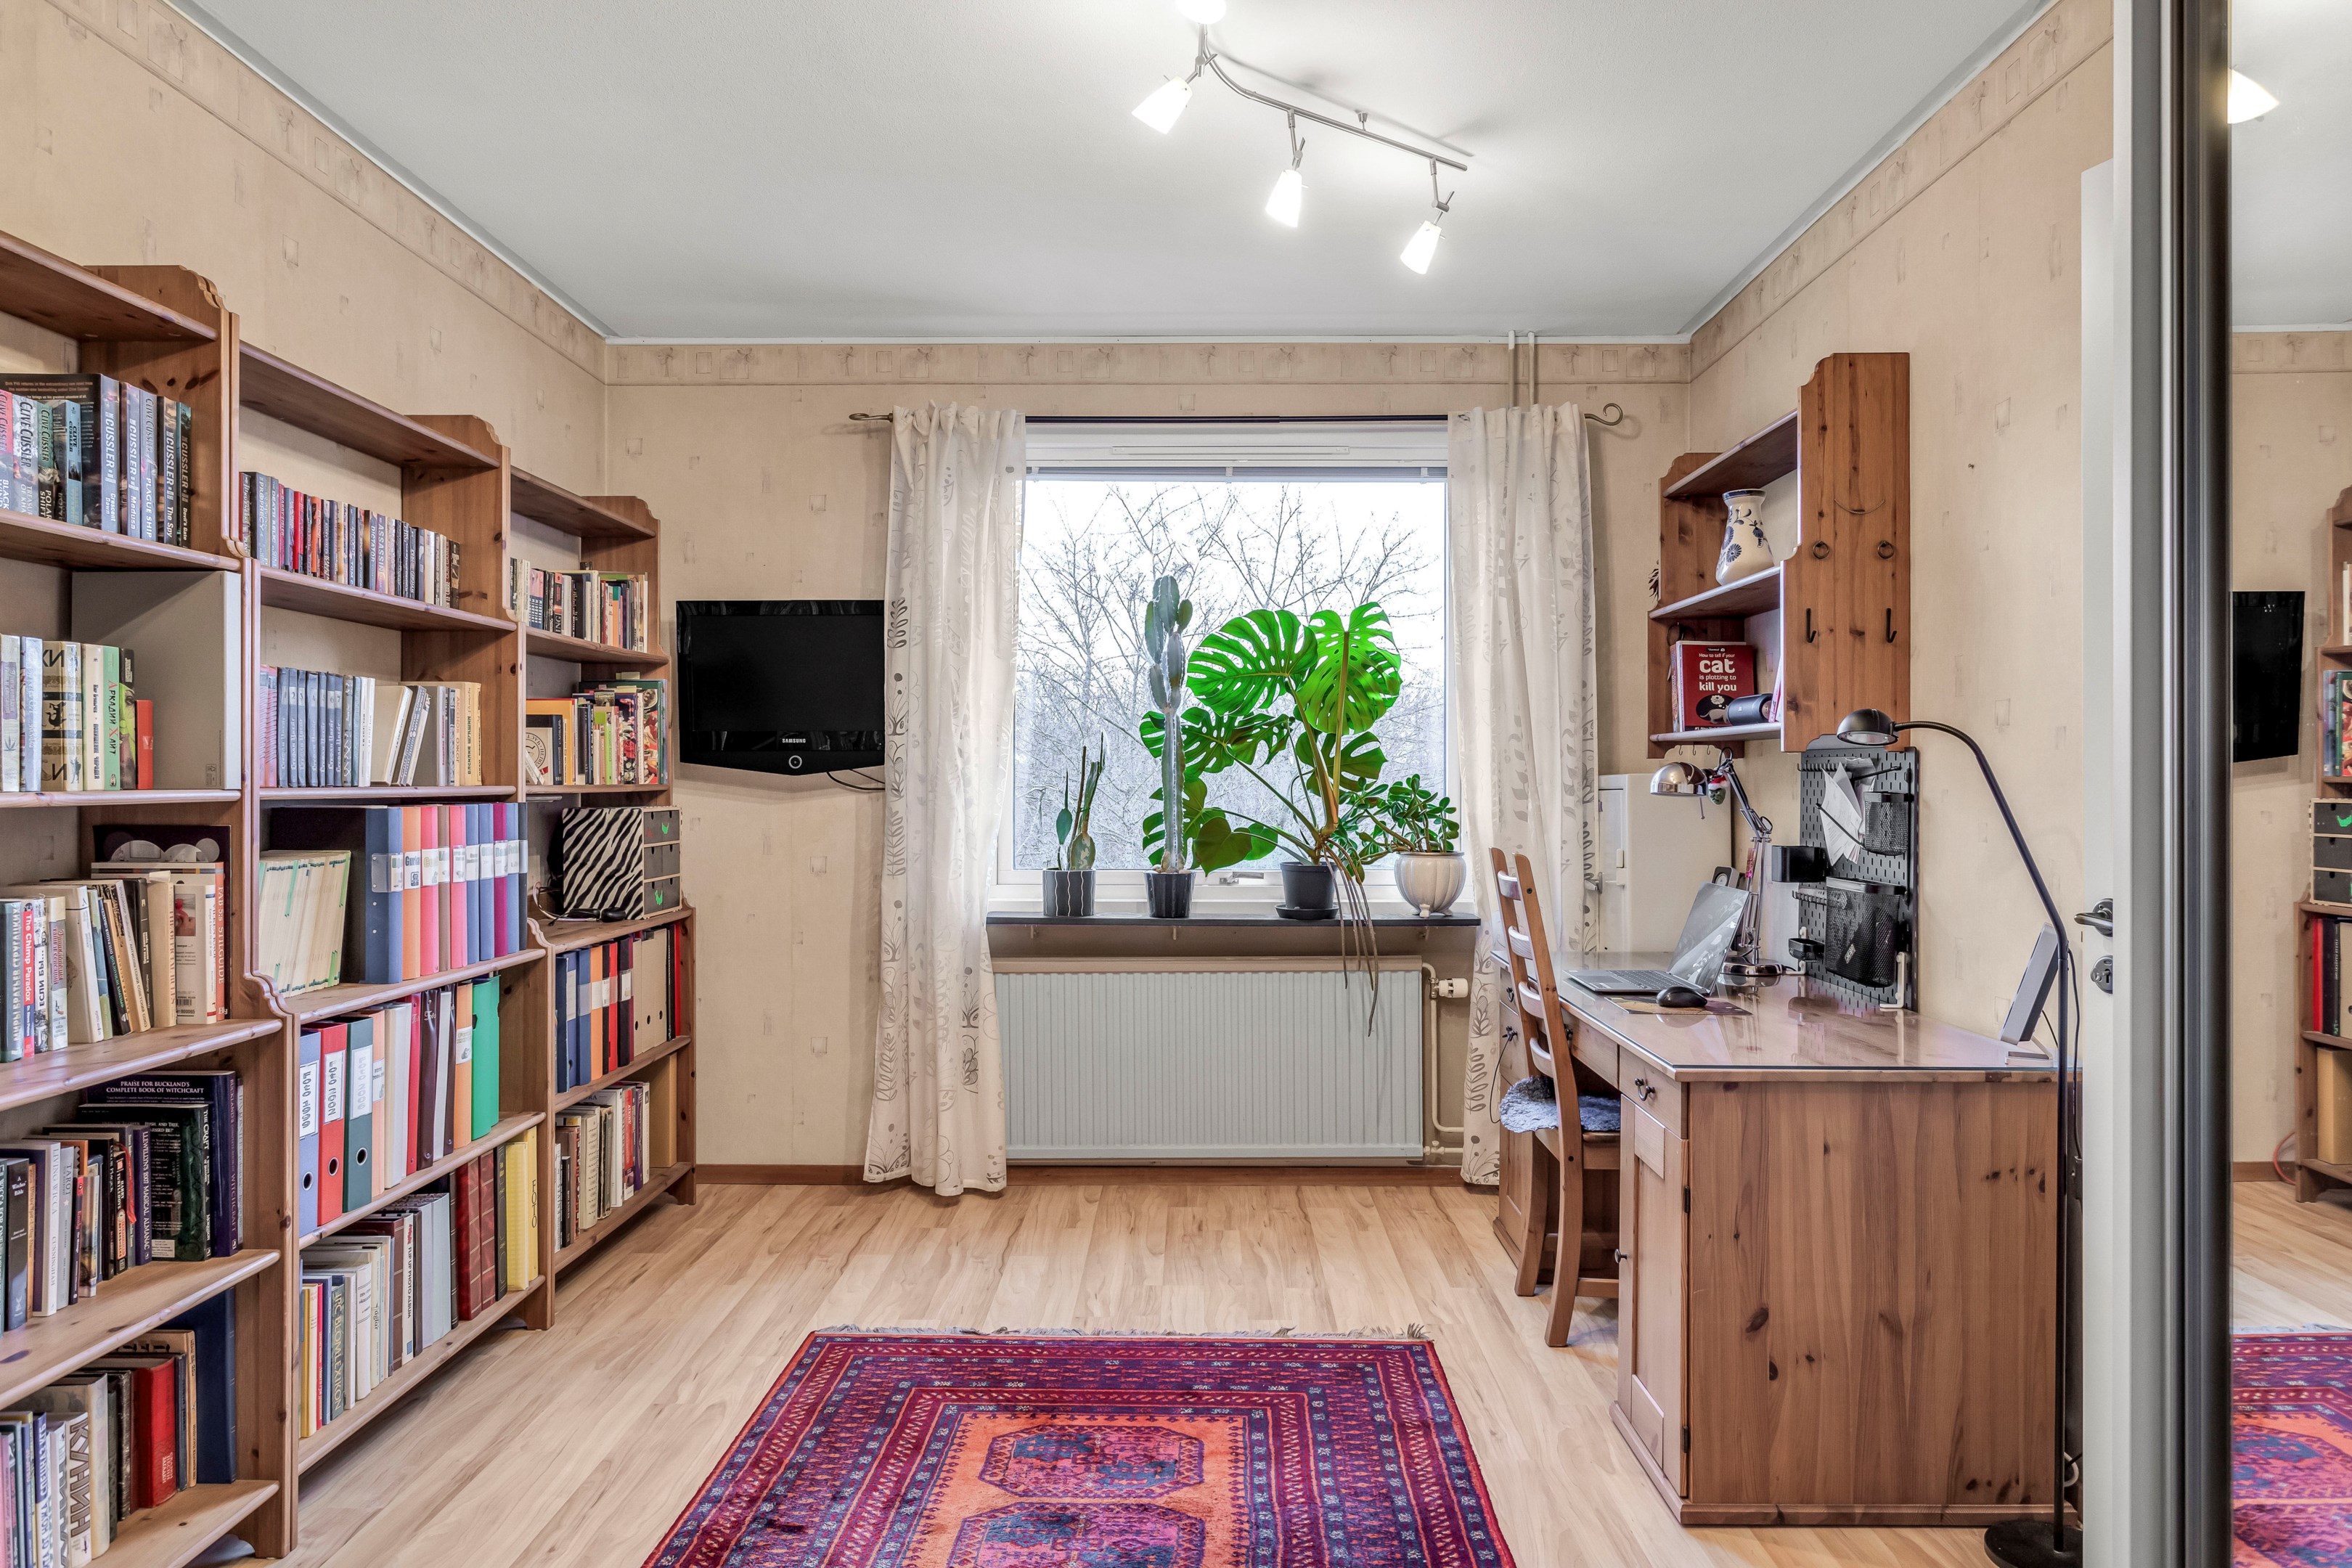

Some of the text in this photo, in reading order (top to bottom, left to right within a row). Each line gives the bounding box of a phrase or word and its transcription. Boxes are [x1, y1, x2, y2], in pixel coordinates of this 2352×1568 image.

[145, 399, 154, 419] CLIVE
[20, 402, 33, 467] CLIVE CUSSLER
[41, 410, 51, 462] CLIVE CUSSLER
[105, 417, 115, 467] CUSSLER
[21, 484, 27, 495] OF
[1699, 658, 1735, 674] cat
[1699, 682, 1736, 693] kill you
[12, 907, 22, 1041] МИРЫ БРАТЬЕВ СТРУГАЦКИХ
[407, 1260, 412, 1270] UP
[70, 1418, 90, 1538] КУНИН
[42, 1538, 49, 1550] ОТ
